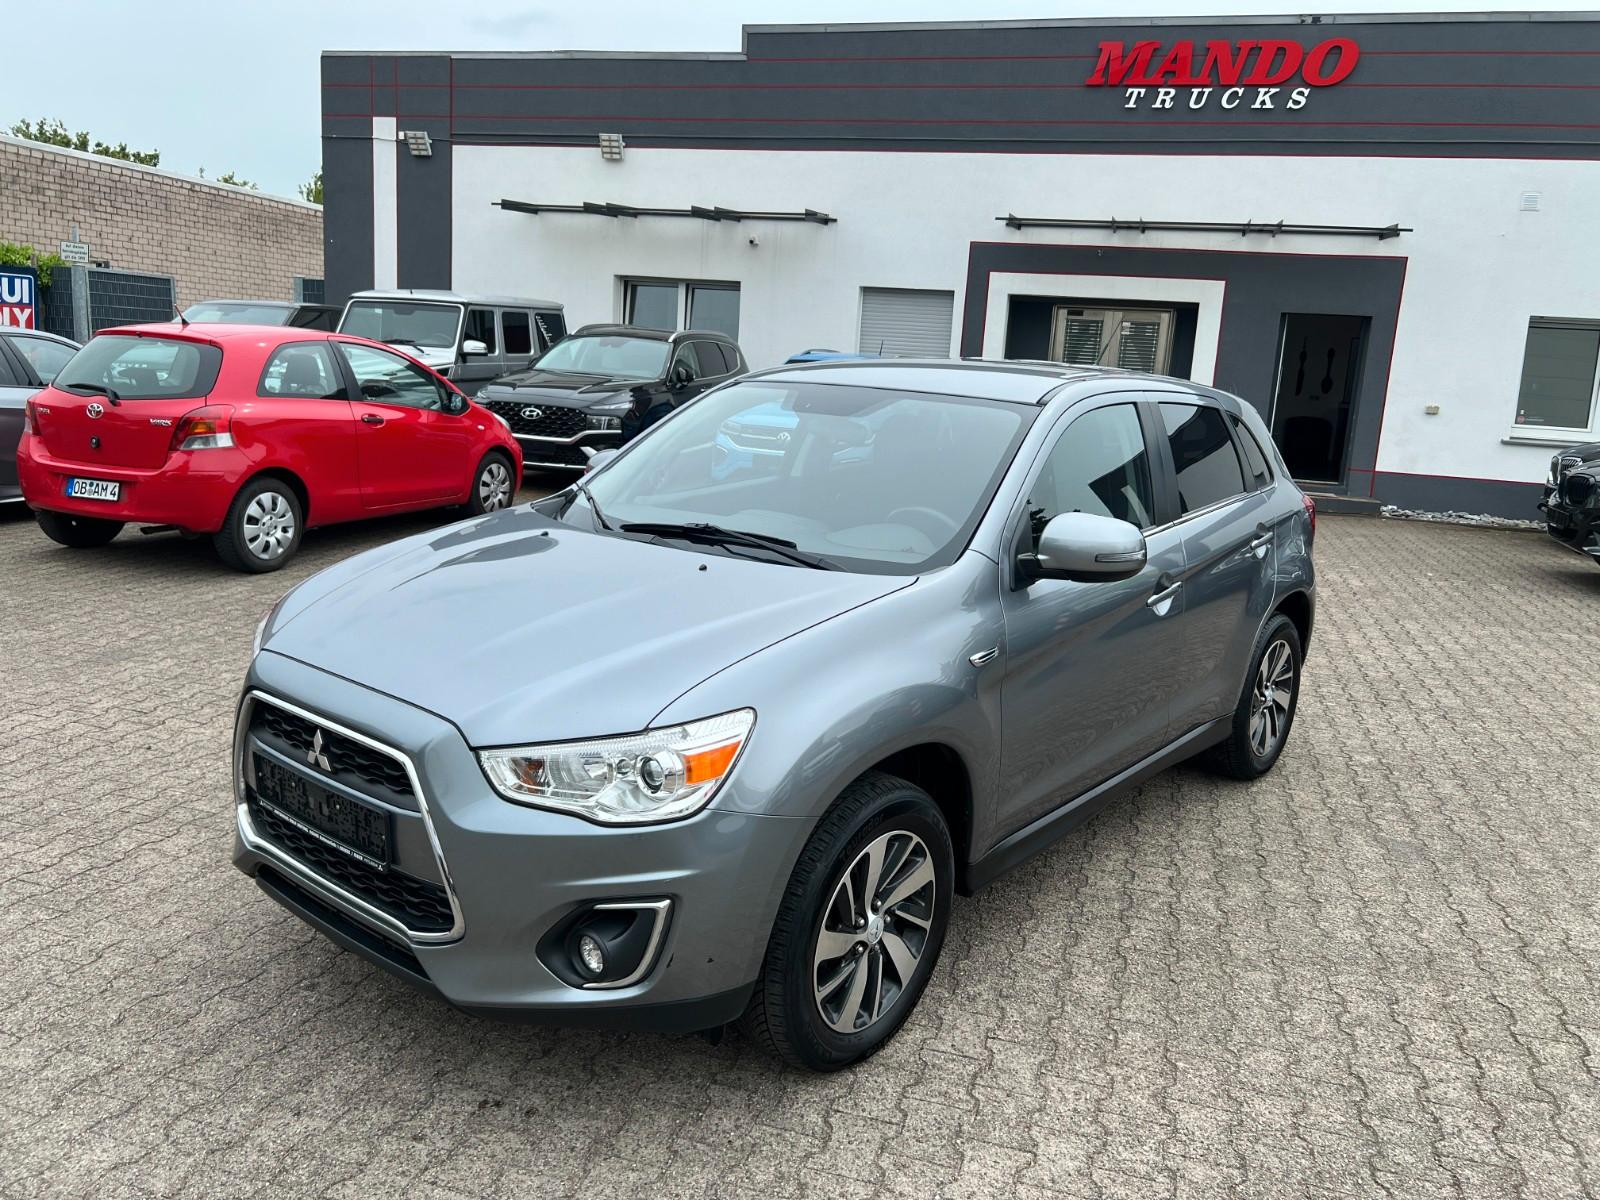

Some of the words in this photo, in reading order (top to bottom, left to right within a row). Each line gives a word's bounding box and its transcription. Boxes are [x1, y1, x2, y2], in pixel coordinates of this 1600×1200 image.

[1085, 37, 1360, 87] MANDO
[1124, 87, 1310, 109] TRUCKS
[0, 277, 30, 304] UI
[73, 480, 88, 495] OB
[93, 482, 109, 497] AM
[110, 484, 117, 498] 4
